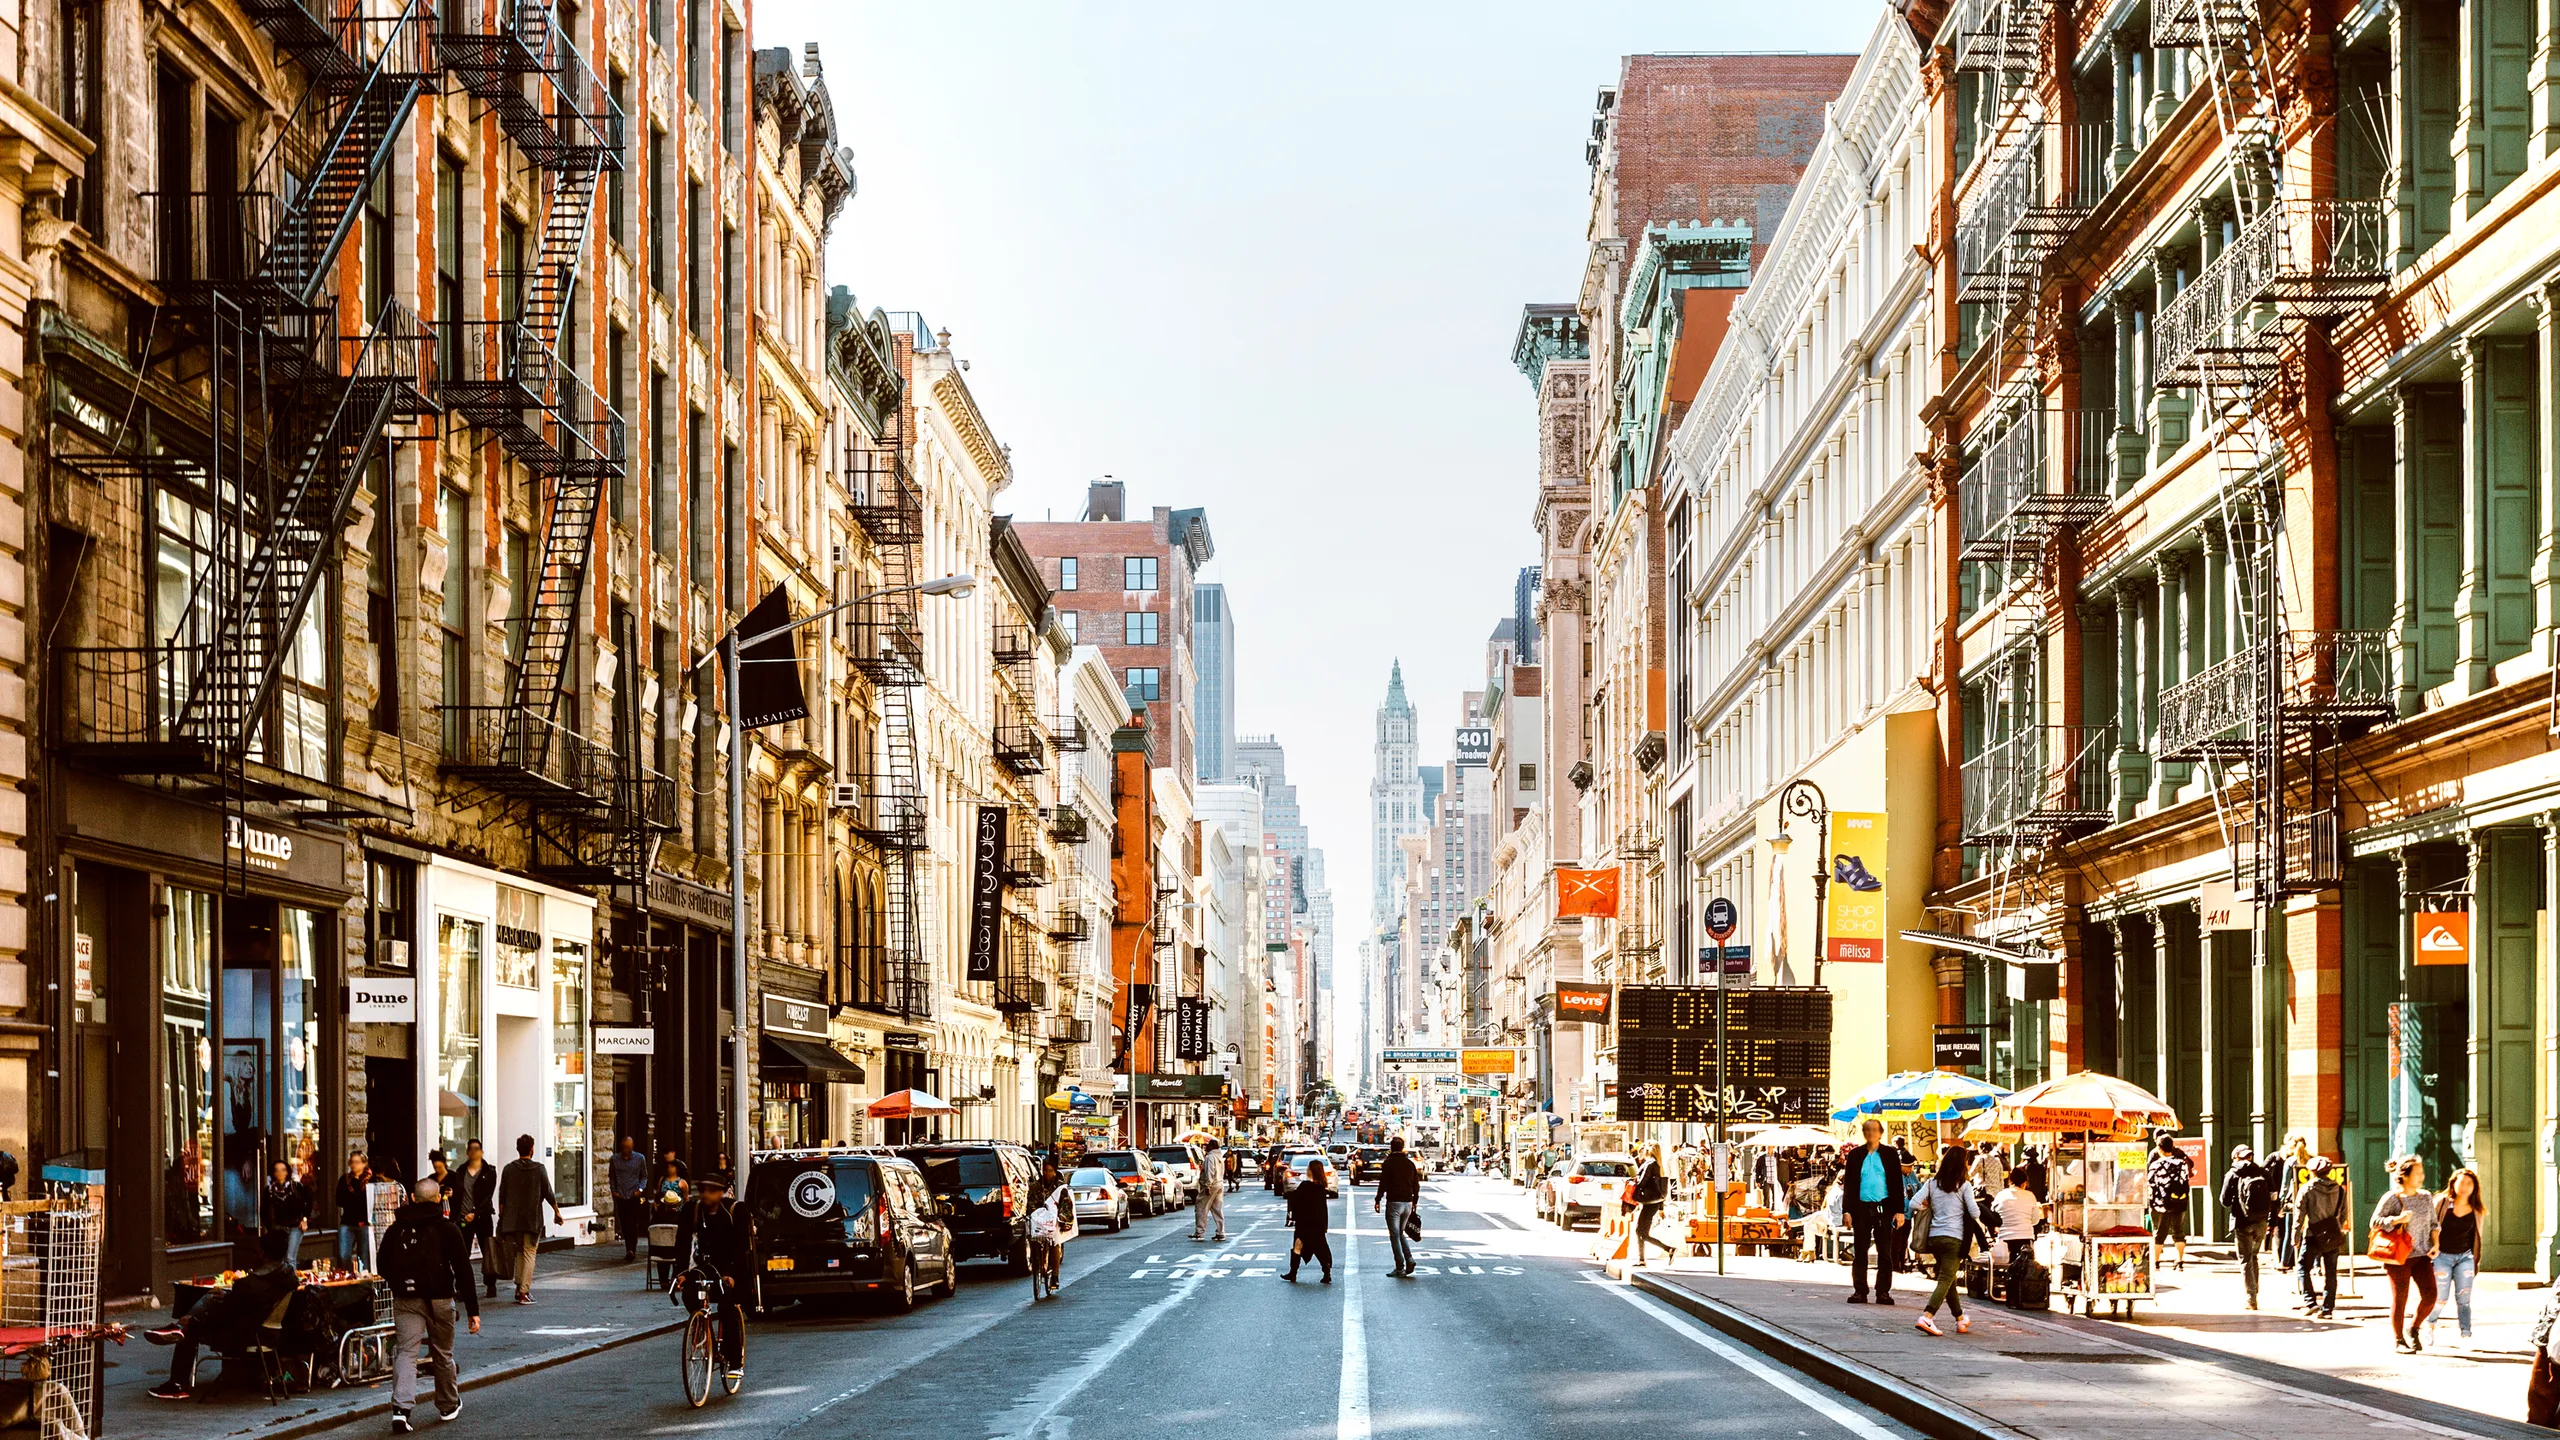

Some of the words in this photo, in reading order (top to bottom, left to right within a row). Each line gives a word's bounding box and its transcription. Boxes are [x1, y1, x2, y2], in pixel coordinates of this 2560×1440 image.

[740, 706, 804, 728] ALLSAINTS
[1457, 731, 1489, 746] 401
[1457, 749, 1490, 759] Broadway
[1847, 819, 1873, 829] NYC
[225, 815, 292, 861] Dune
[1838, 905, 1875, 917] SHOP
[1836, 919, 1877, 932] SOHO
[496, 925, 542, 950] MARCIANO
[1700, 949, 1711, 959] M5
[1840, 944, 1871, 958] melissa
[1700, 961, 1711, 971] M5
[356, 992, 408, 1004] Dune
[1672, 992, 1749, 1030] ONE
[1181, 1002, 1191, 1053] TOPSHOP
[1195, 1008, 1203, 1055] TOPMAN
[598, 1038, 650, 1046] MARCIANO
[1936, 1044, 1952, 1052] TRUE
[1672, 1039, 1776, 1077] LANE
[2045, 1109, 2058, 1117] ALL
[2060, 1110, 2092, 1119] NATURAL
[2089, 1121, 2108, 1129] NUTS
[1144, 1252, 1287, 1264] LANE
[1129, 1266, 1278, 1280] FIRE
